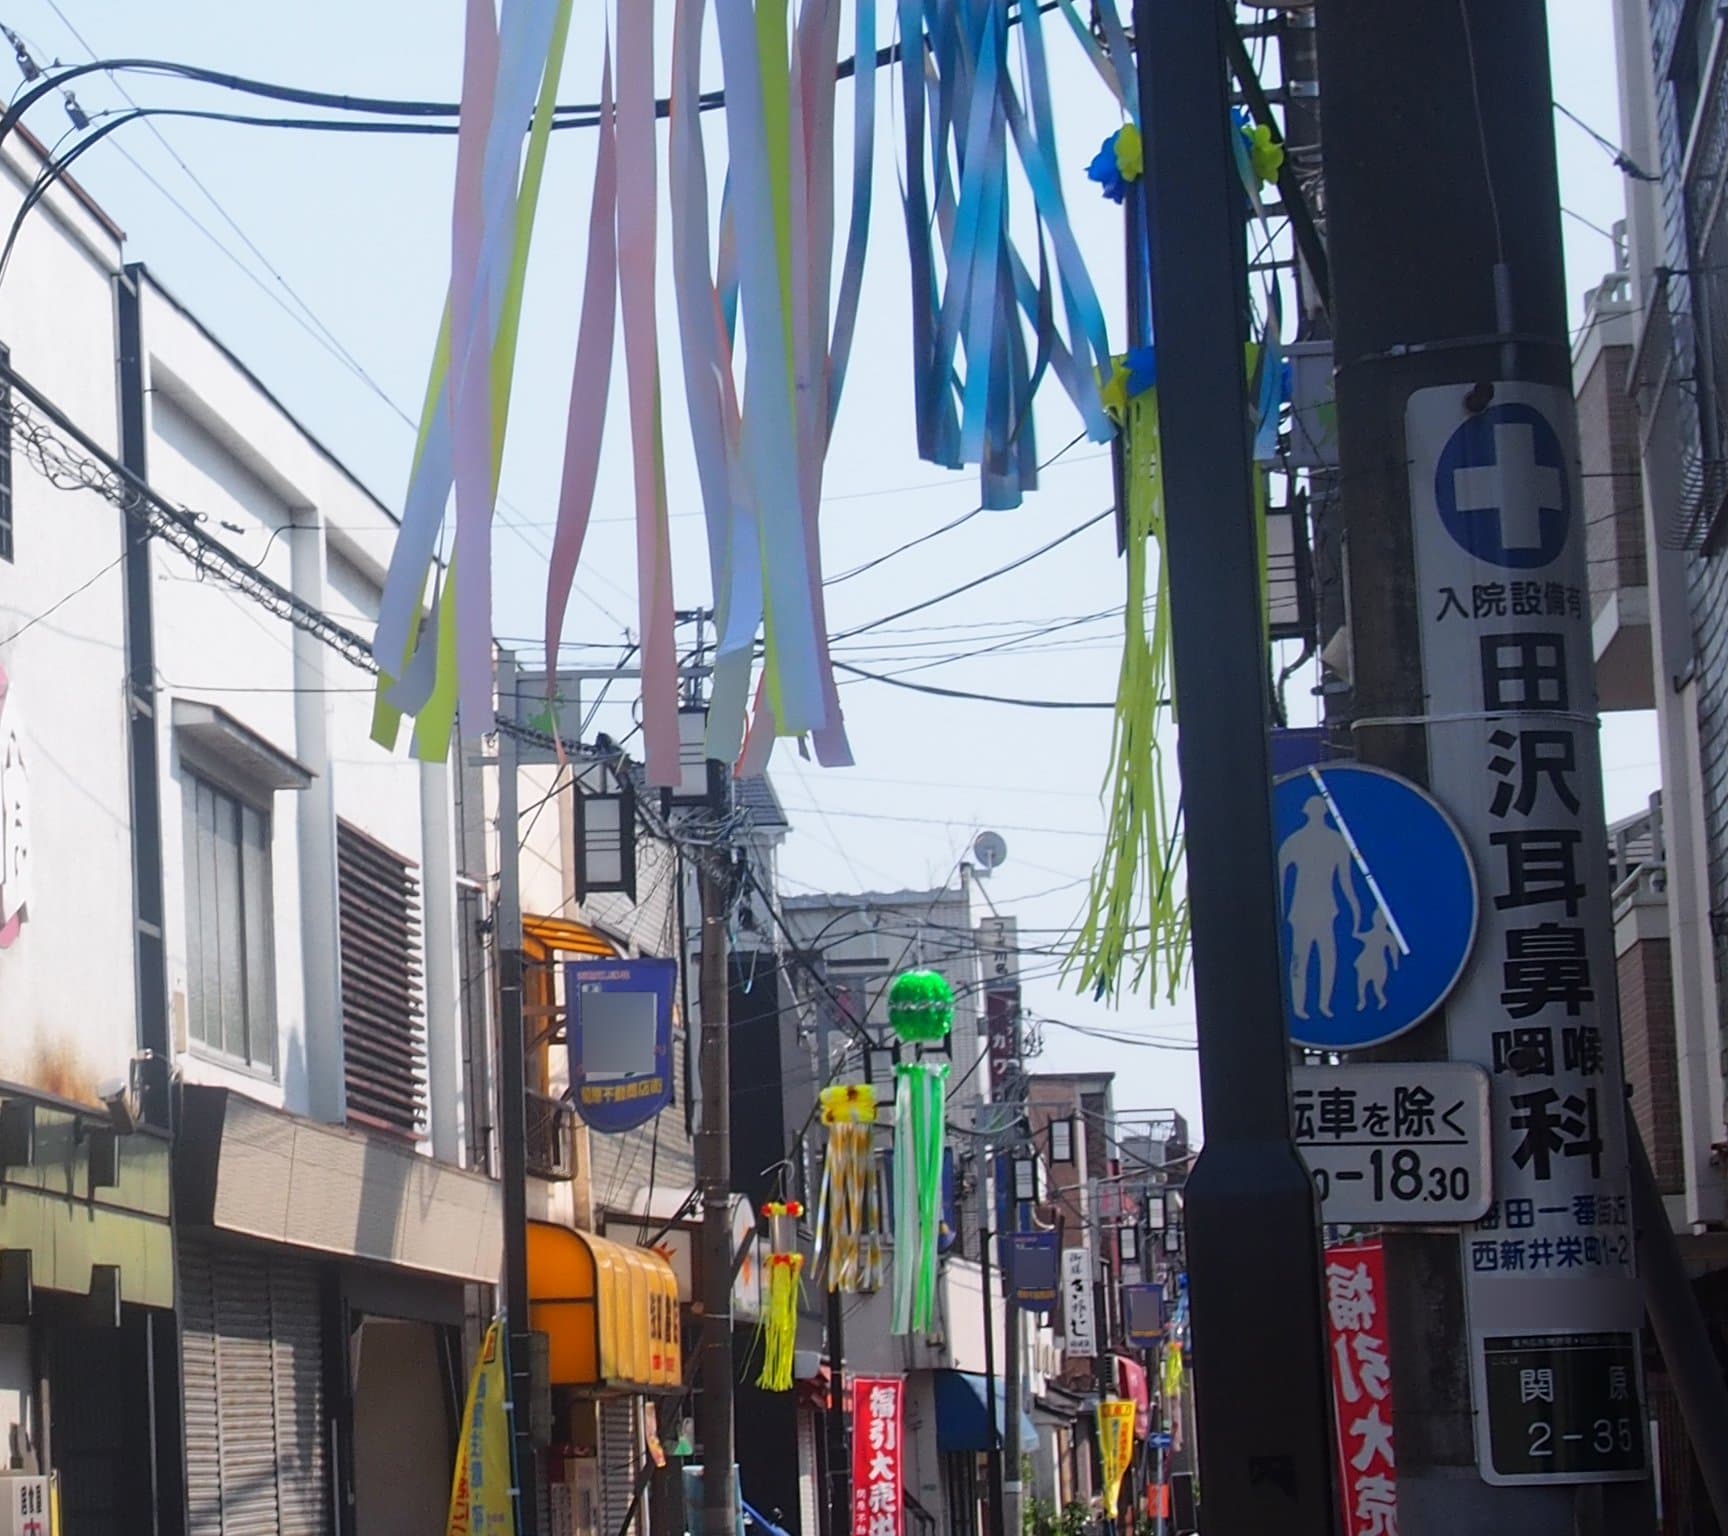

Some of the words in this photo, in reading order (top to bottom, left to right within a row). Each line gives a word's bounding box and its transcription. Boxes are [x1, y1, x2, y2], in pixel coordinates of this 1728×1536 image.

[1436, 581, 1582, 622] 入院設備有
[1519, 1366, 1629, 1404] 関原
[1527, 1418, 1632, 1457] 2-35
